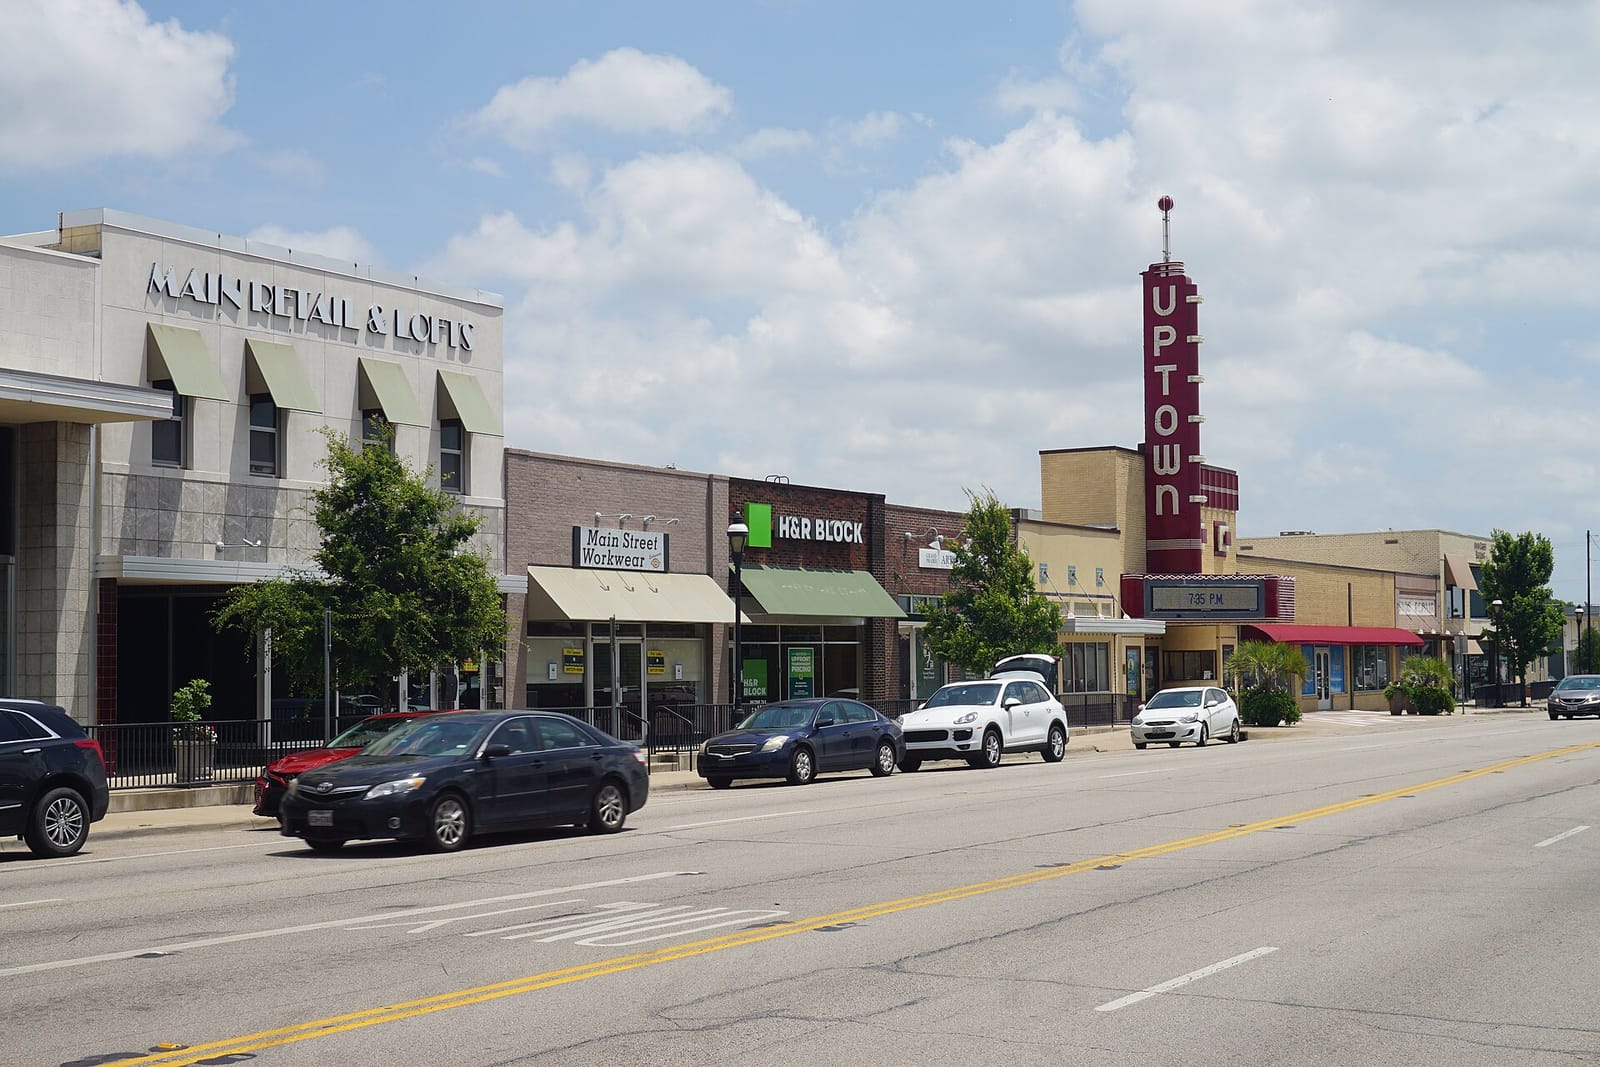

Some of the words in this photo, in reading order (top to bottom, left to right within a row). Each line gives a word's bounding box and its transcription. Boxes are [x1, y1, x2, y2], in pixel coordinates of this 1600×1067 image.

[147, 261, 242, 310] MAIN
[249, 280, 360, 331] RETAIL
[367, 303, 387, 335] &
[395, 307, 475, 352] LOFTS
[586, 529, 620, 548] Main
[622, 532, 658, 551] Street
[777, 515, 812, 541] H&R
[814, 517, 864, 545] BLOCK
[582, 547, 645, 568] Workwear
[743, 678, 759, 687] H&R
[743, 687, 767, 696] BLOCK
[343, 898, 791, 947] ONLY
